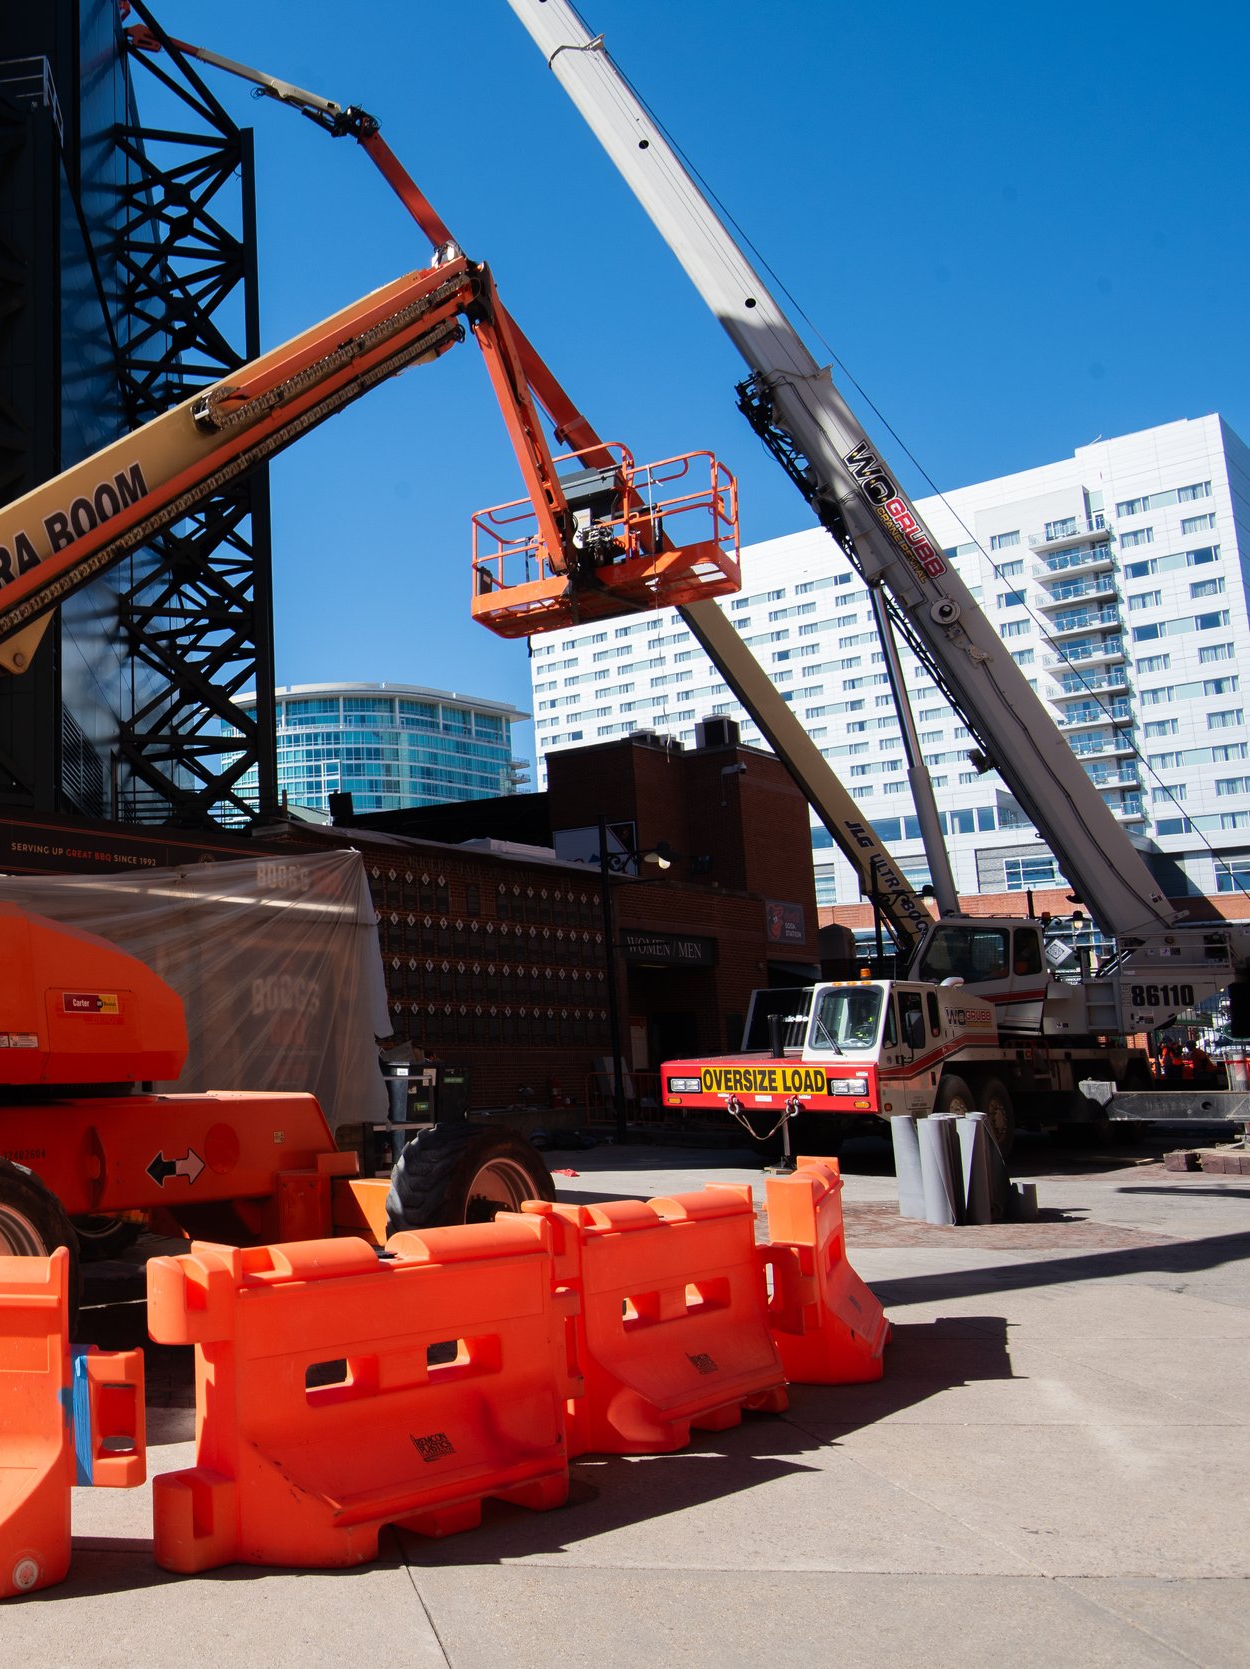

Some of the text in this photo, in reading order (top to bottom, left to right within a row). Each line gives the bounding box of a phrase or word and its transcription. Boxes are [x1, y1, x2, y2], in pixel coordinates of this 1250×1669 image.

[43, 460, 150, 555] BOOM
[876, 506, 901, 541] CRANE
[885, 498, 947, 579] GRUBB
[844, 820, 875, 849] JLG
[11, 842, 50, 854] SERVING
[52, 847, 64, 855] UP
[65, 849, 93, 860] GREAT
[94, 852, 112, 862] BBQ
[113, 854, 138, 865] SINCE
[627, 936, 671, 957] WOMEN
[678, 942, 702, 960] MEN
[72, 998, 90, 1007] Carter
[1131, 984, 1195, 1007] 86110
[965, 1009, 991, 1021] GRUBB
[702, 1068, 826, 1093] OVERSIZE LOAD
